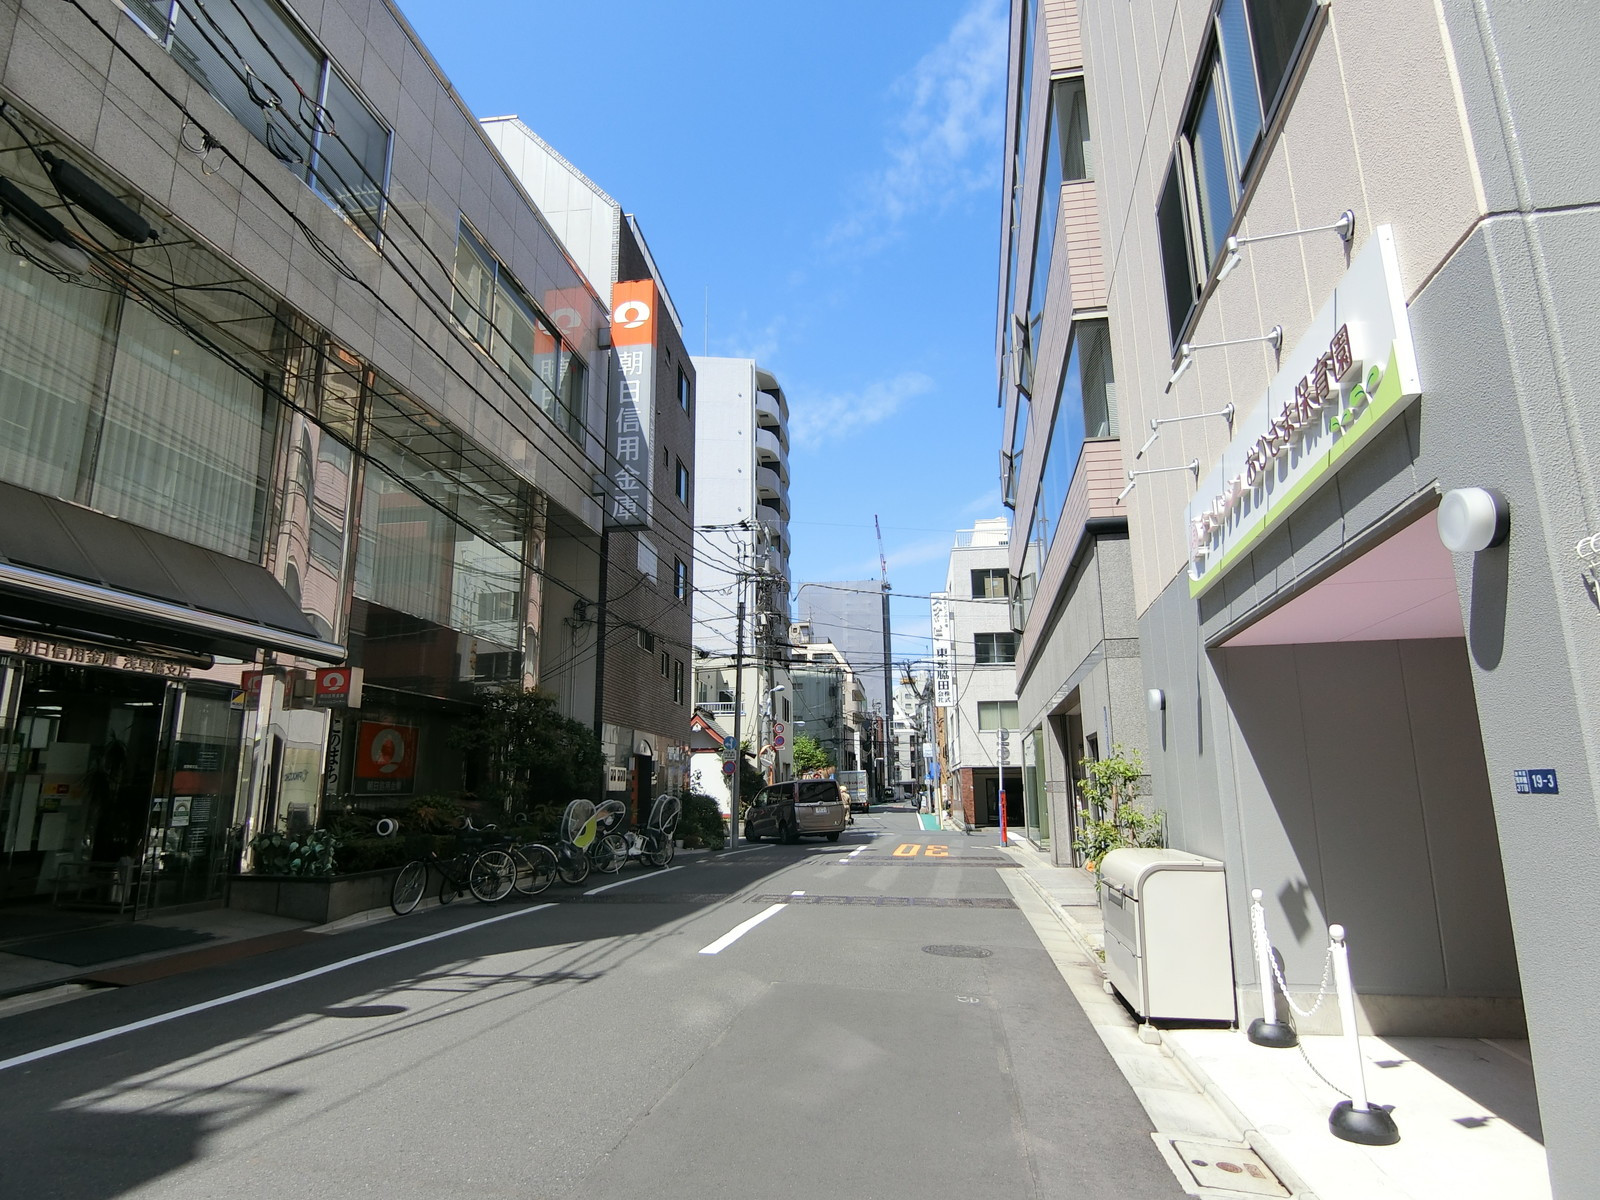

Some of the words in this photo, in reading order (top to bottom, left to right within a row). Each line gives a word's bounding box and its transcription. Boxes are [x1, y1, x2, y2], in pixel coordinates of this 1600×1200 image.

[611, 351, 643, 521] 朝日信用金庫
[1245, 322, 1352, 487] おひさま保育園
[14, 636, 118, 668] 朝日信用金庫
[123, 654, 192, 678] 浅草橋支店
[1531, 774, 1554, 788] 19-3
